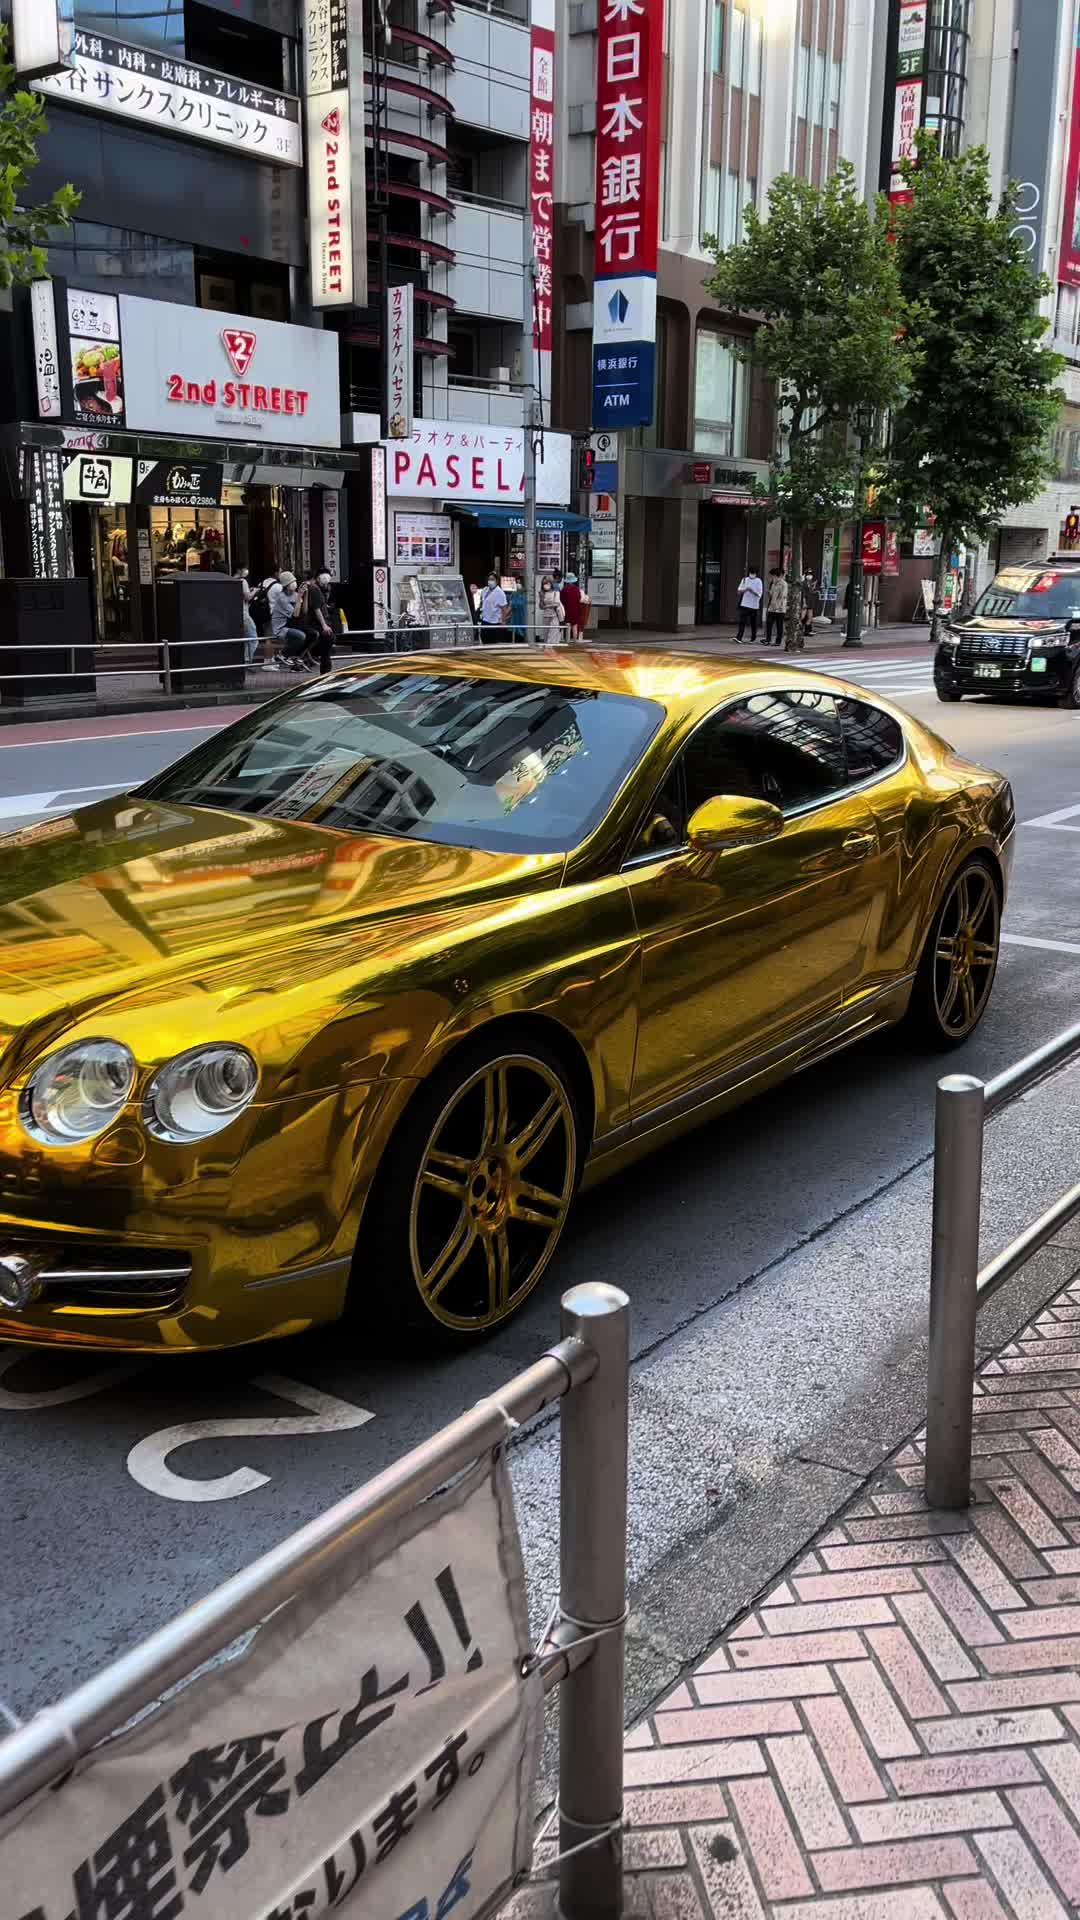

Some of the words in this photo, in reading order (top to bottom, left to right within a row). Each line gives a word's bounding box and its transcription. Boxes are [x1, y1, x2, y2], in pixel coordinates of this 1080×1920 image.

[308, 9, 318, 81] クリニック
[901, 55, 921, 74] 3F
[325, 141, 339, 191] 2nd
[531, 107, 552, 331] 朝まで営業中
[328, 199, 342, 293] STREET
[391, 288, 406, 357] カラオケ
[391, 363, 406, 408] パセラ
[597, 356, 638, 372] 横浜銀行
[166, 374, 217, 405] 2nd
[222, 383, 311, 416] STREET
[604, 393, 630, 408] ATM
[394, 429, 523, 454] ラオケ&パーティ
[84, 465, 108, 490] 牛角
[536, 519, 564, 529] RESORTS
[20, 1565, 483, 1920] 煙禁止!!
